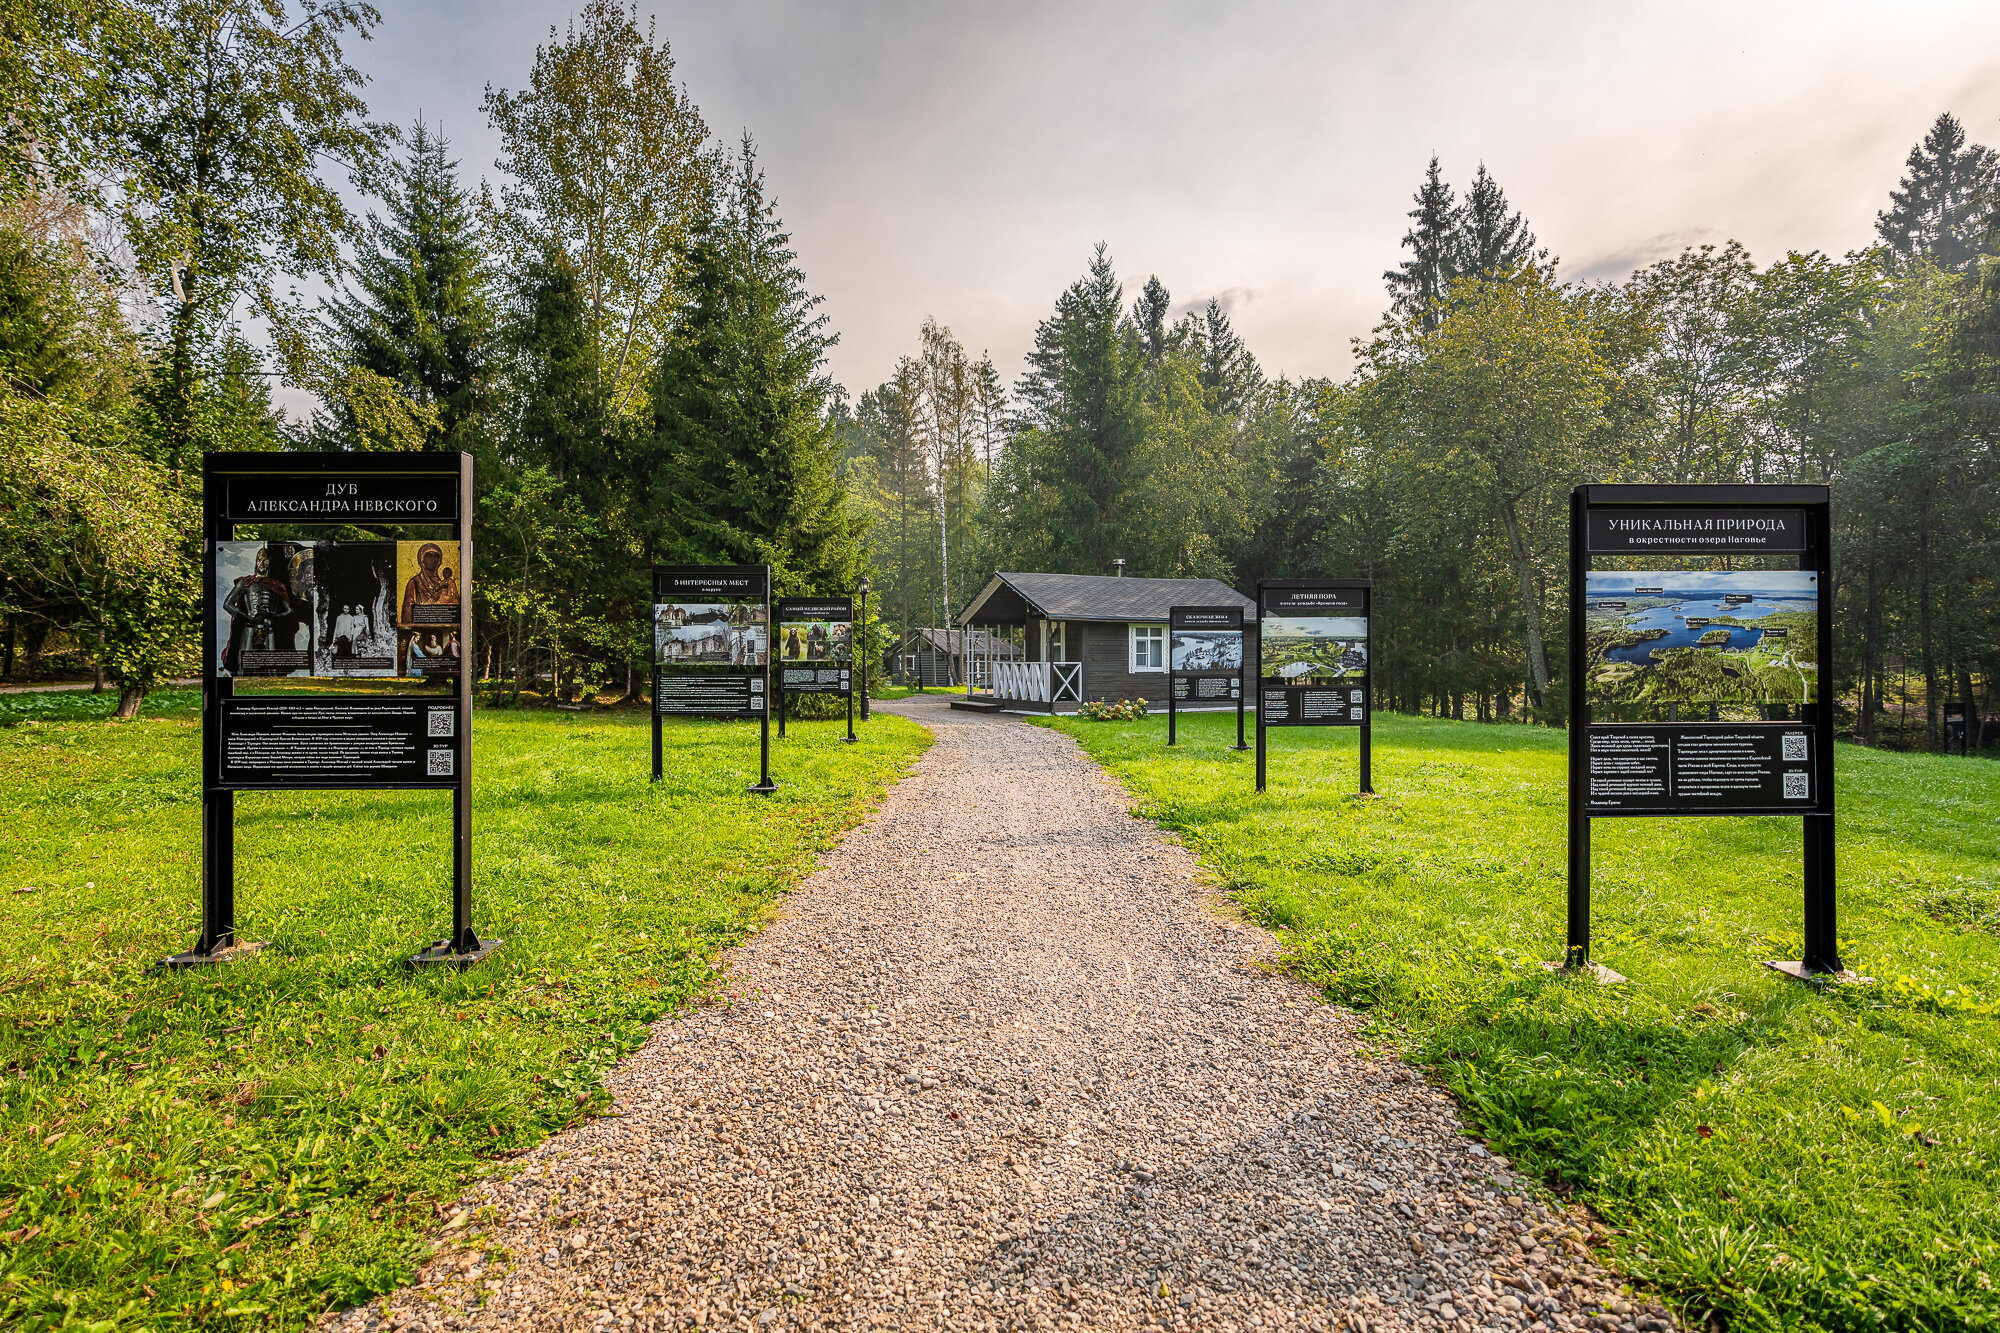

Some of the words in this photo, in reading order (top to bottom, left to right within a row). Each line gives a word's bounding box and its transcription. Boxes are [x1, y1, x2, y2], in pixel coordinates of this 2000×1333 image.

[325, 484, 358, 496] ДУБ
[247, 499, 350, 512] АЛЕКСАНДРА
[354, 499, 437, 512] НЕВСКОГО
[1608, 519, 1713, 530] УНИКАЛЬНАЯ
[1716, 519, 1786, 531] ПРИРОДА
[1636, 537, 1697, 545] окрестности
[1698, 537, 1727, 545] озера
[1728, 536, 1767, 544] Наговье
